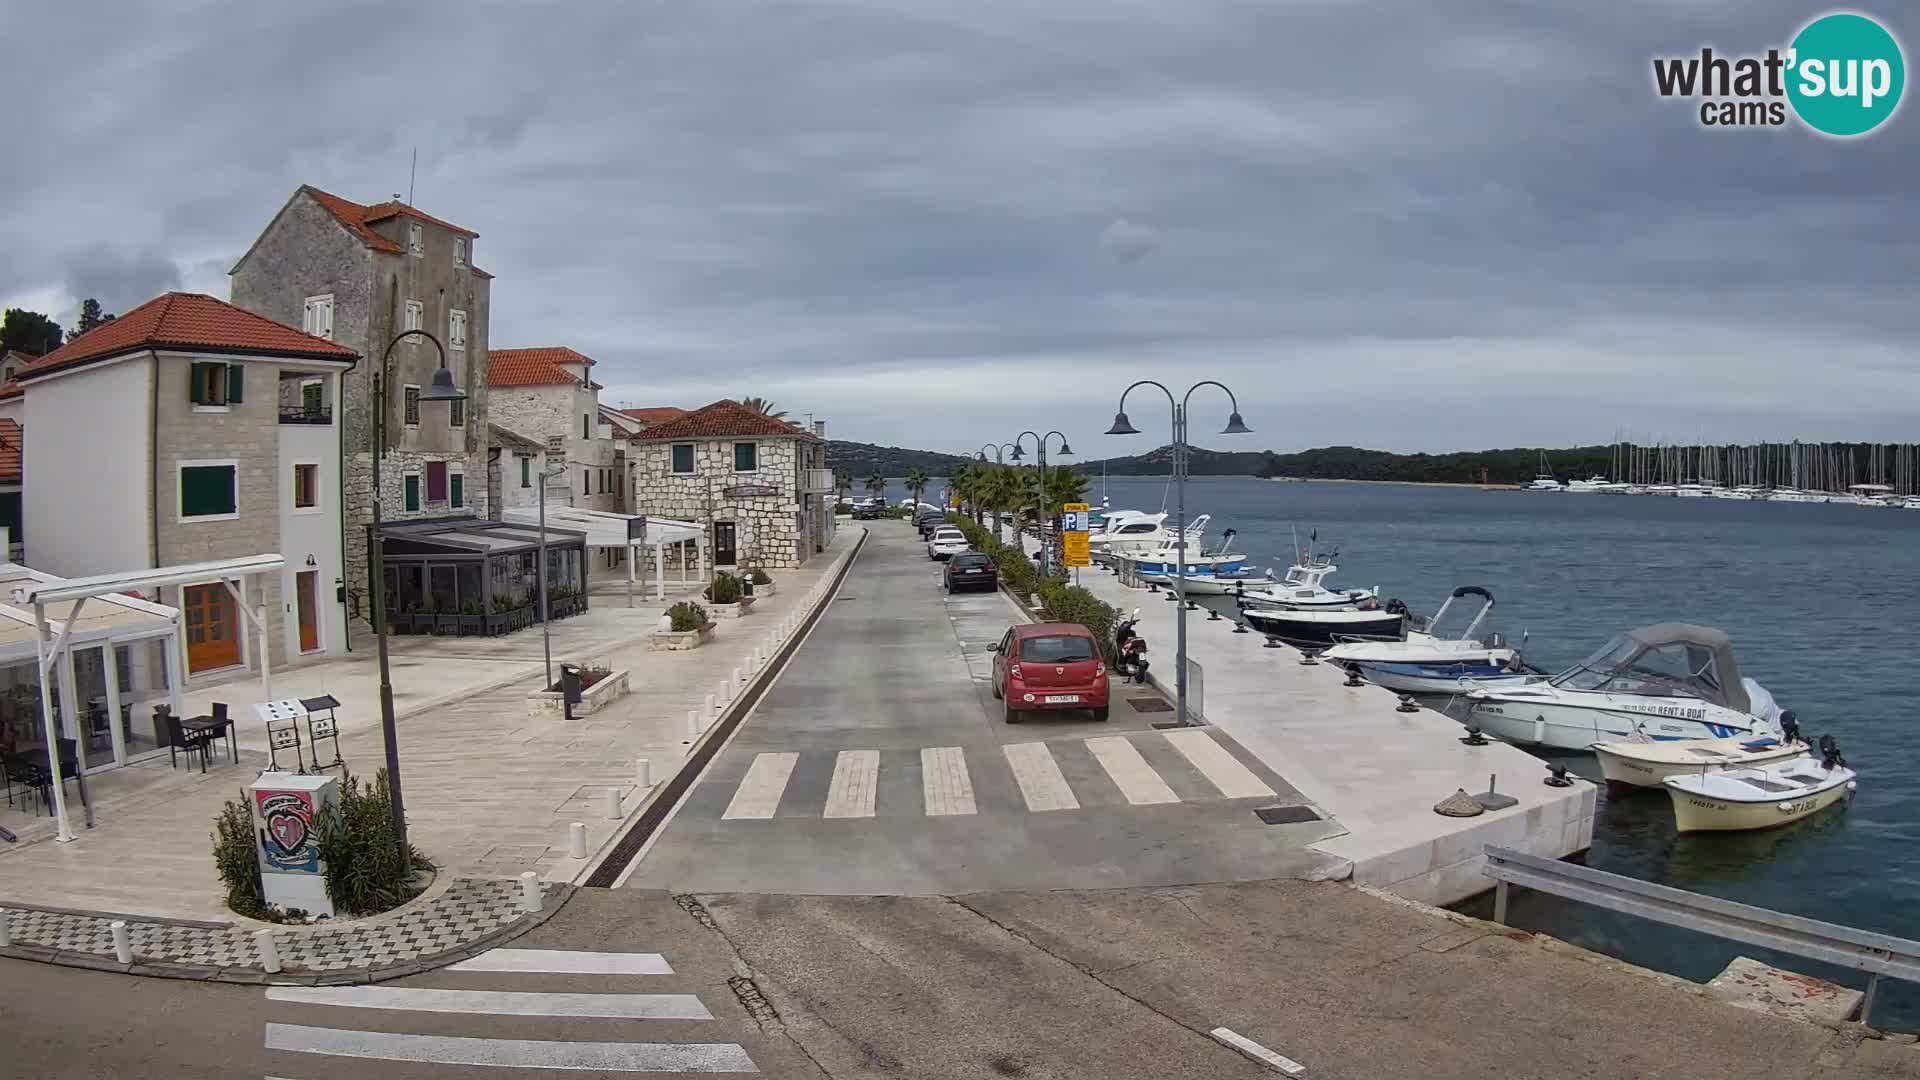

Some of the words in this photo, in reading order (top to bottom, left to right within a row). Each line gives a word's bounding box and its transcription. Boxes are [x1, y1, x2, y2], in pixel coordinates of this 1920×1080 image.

[1065, 513, 1076, 530] P
[1657, 705, 1680, 717] RENT
[1680, 708, 1685, 717] A
[1686, 707, 1707, 720] BOAT
